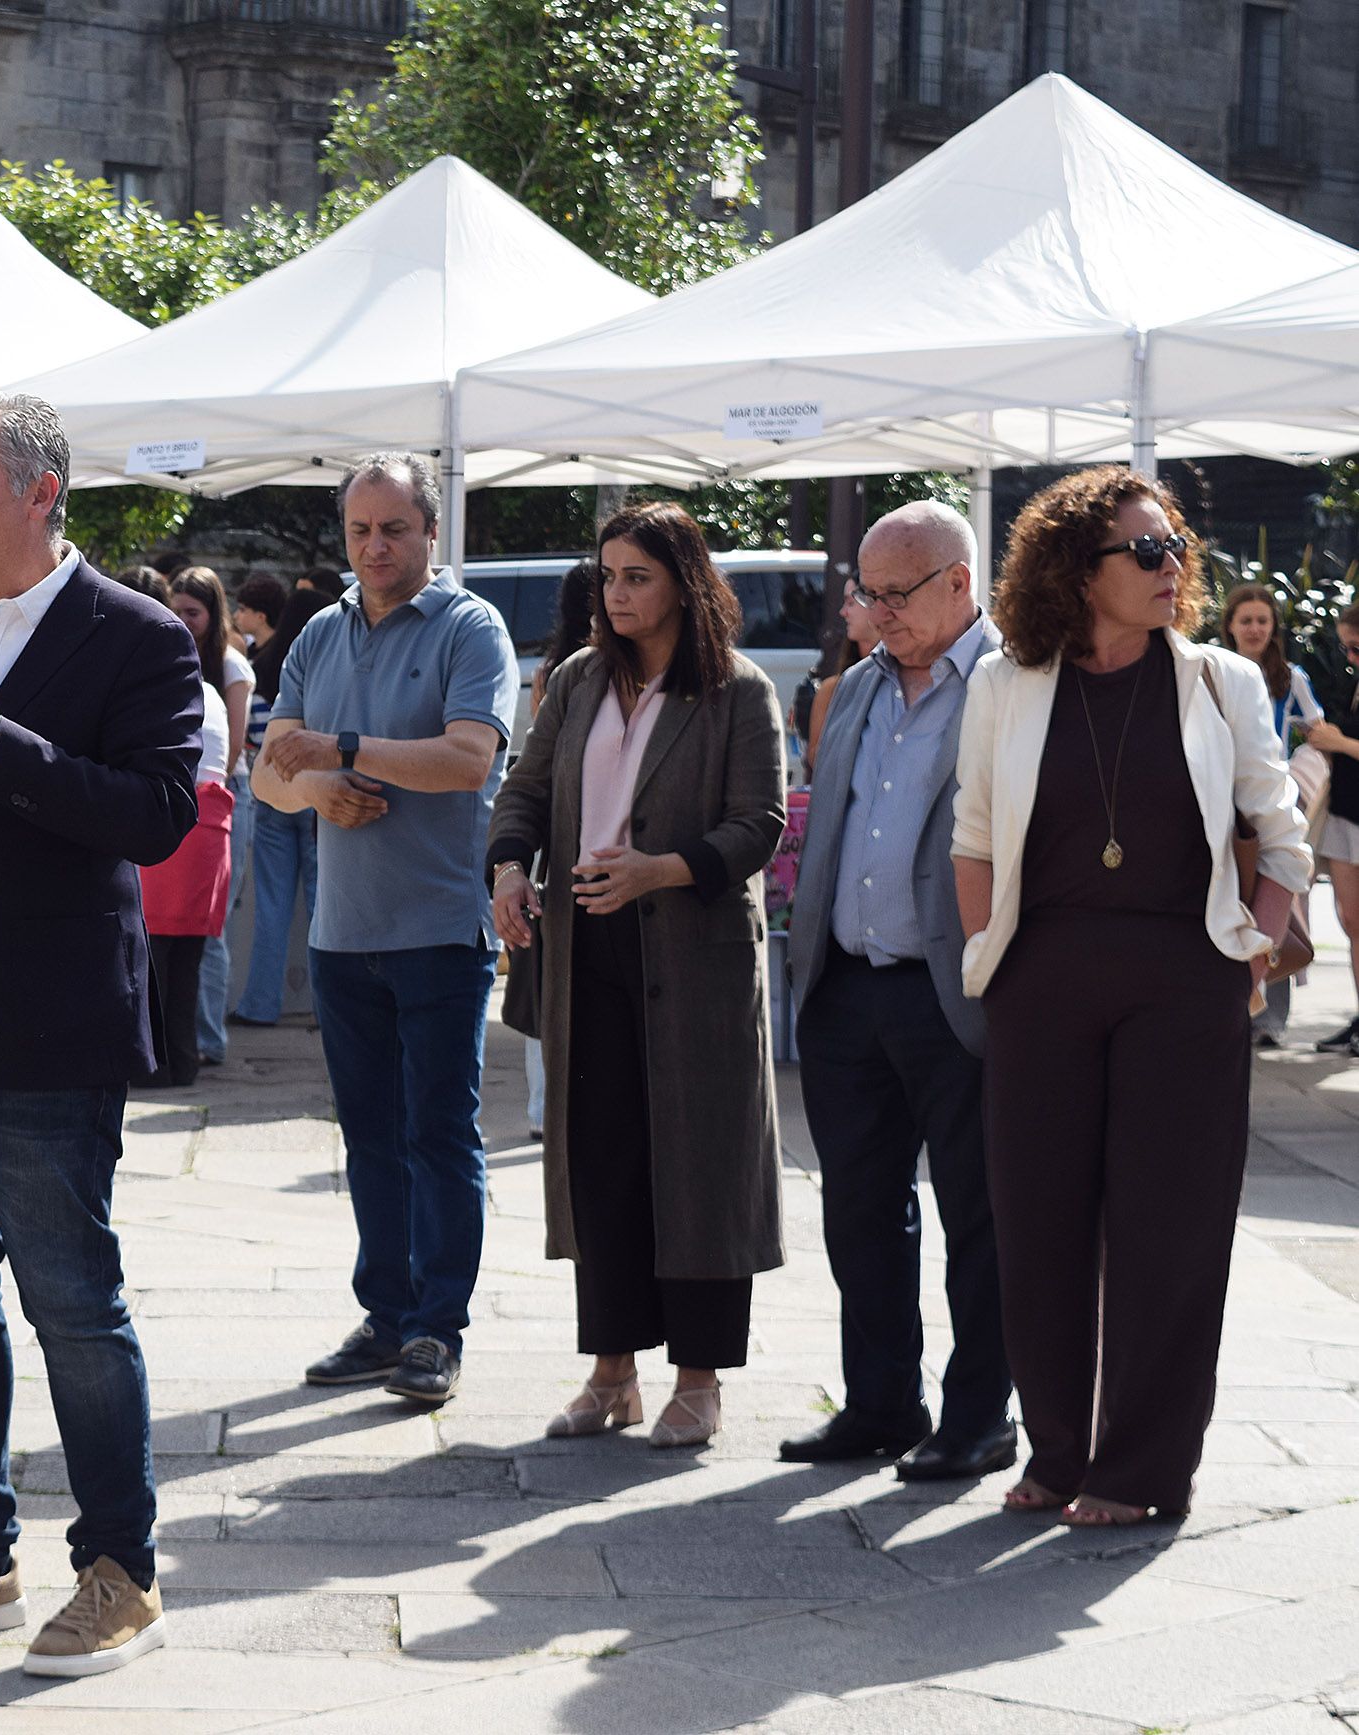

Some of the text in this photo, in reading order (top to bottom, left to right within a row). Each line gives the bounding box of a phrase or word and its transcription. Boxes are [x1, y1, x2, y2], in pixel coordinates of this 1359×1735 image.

[728, 402, 818, 418] MAR DE ALGODÓN
